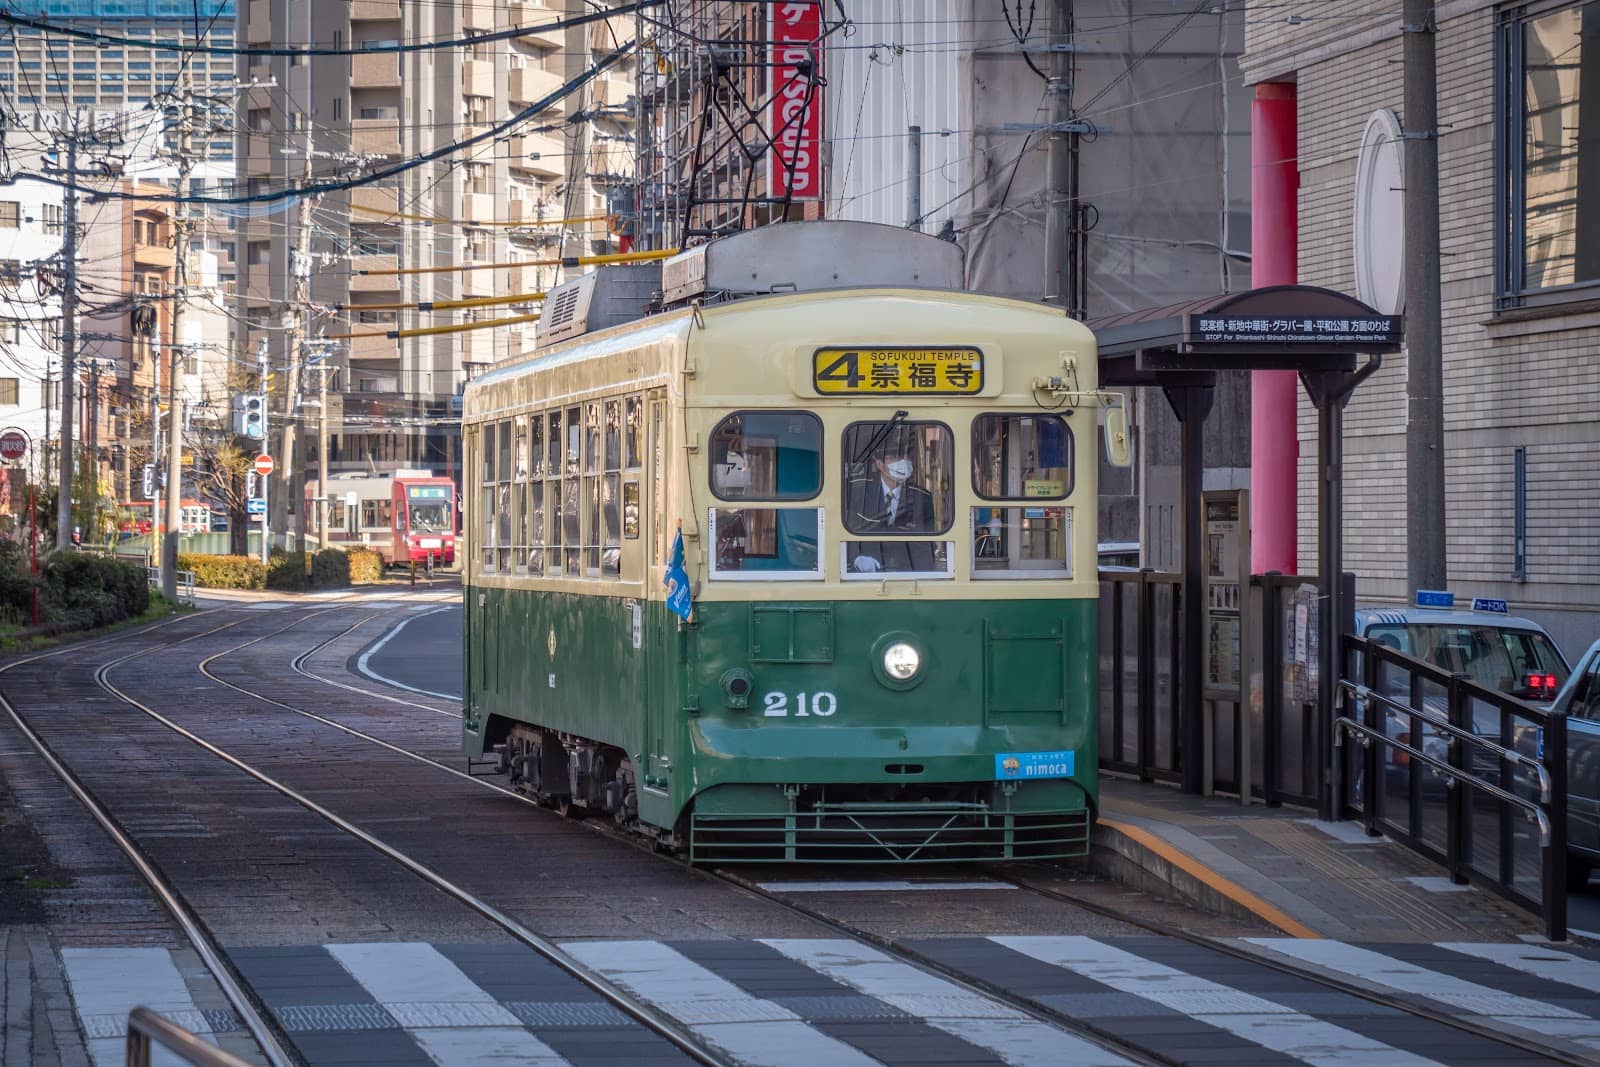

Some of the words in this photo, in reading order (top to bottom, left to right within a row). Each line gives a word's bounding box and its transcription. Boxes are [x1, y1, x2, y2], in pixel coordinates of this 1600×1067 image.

[1351, 319, 1391, 332] 方面のりば
[870, 352, 927, 361] SOFUKUJI
[930, 352, 974, 361] TEMPLE
[817, 352, 866, 388] 4
[870, 363, 974, 388] 崇福寺
[1476, 600, 1506, 612] カードOK
[764, 691, 837, 717] 210
[1025, 761, 1067, 776] nimoca
